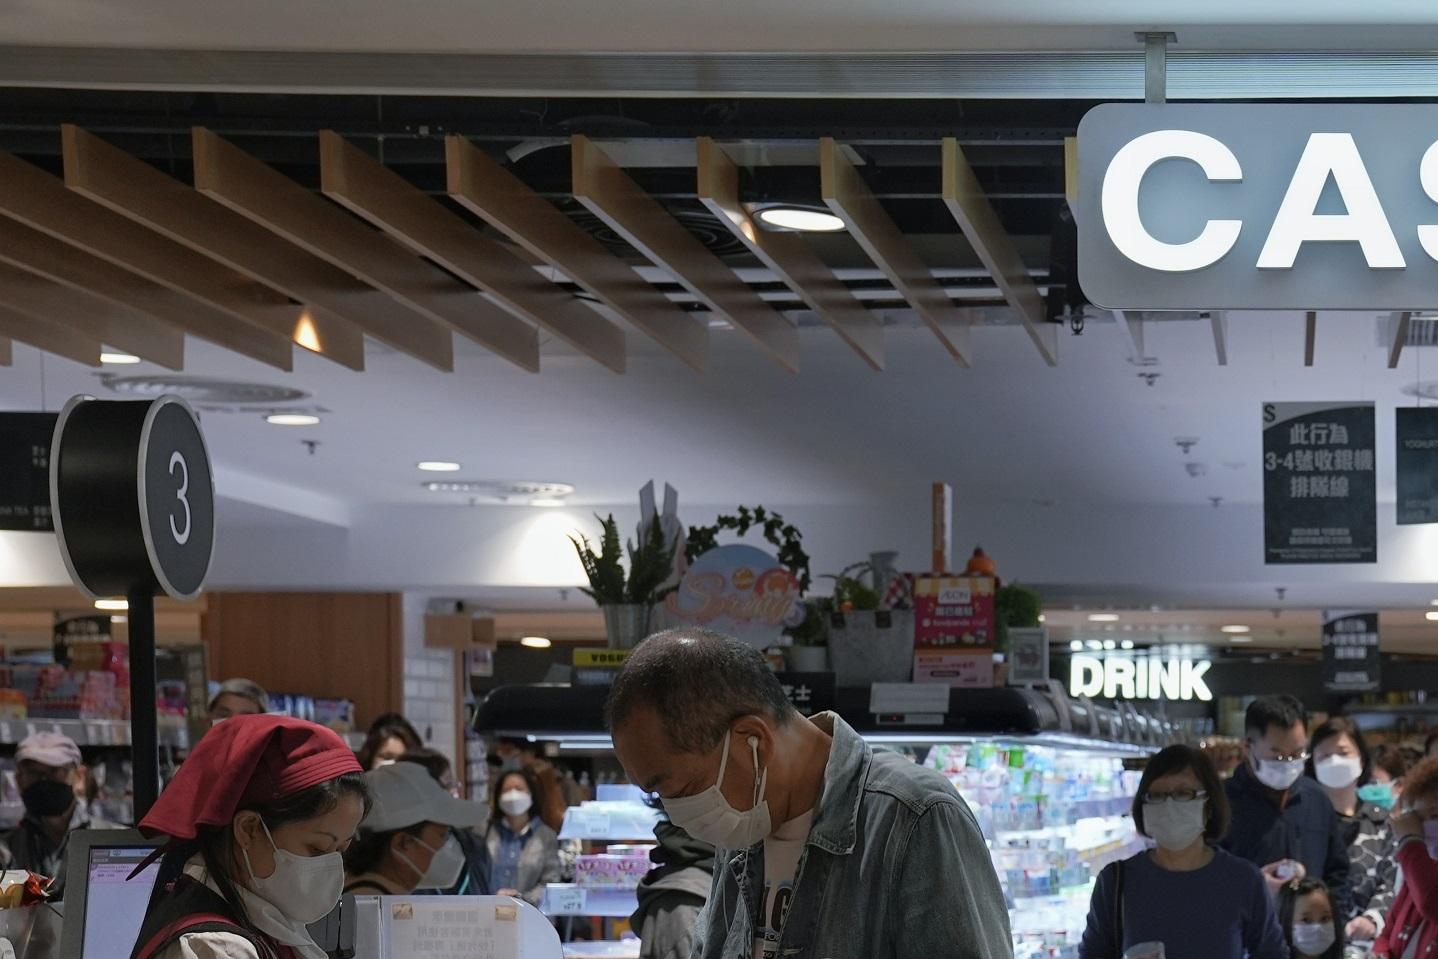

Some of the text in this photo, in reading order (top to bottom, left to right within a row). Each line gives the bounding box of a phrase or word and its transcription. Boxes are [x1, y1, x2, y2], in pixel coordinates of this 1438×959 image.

[1289, 422, 1349, 445] 此行為
[1265, 449, 1374, 471] 3-4號收銀機
[169, 451, 191, 545] 3
[1070, 653, 1213, 701] DRINK
